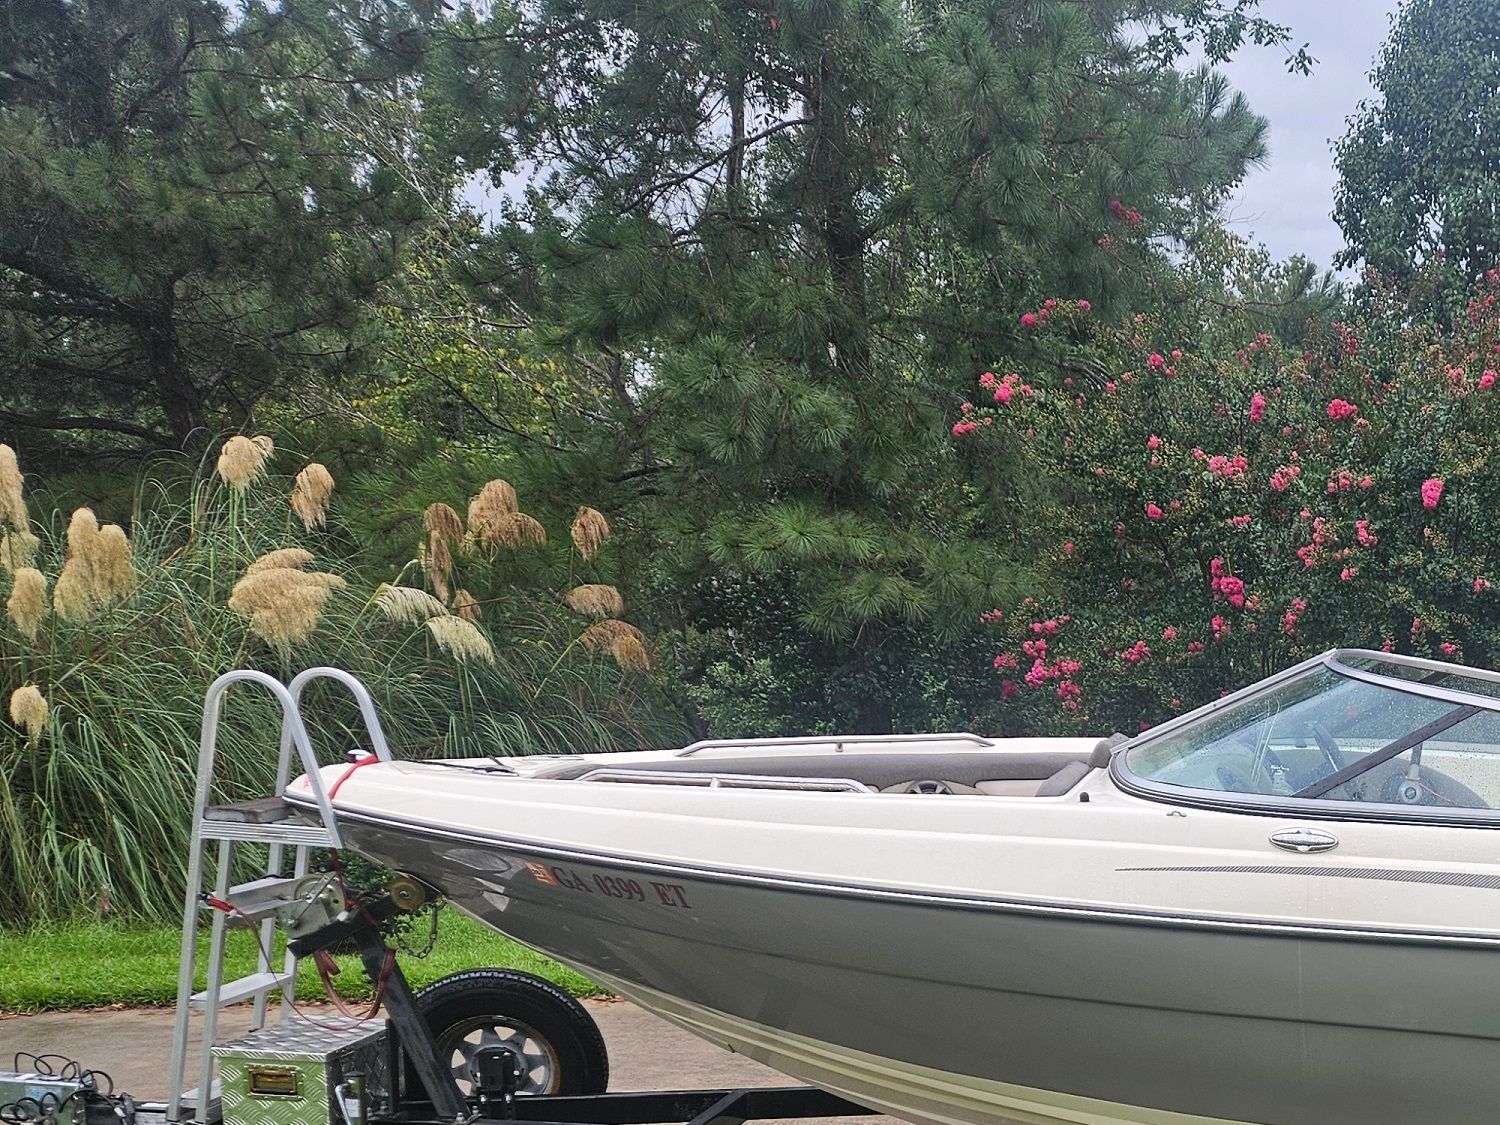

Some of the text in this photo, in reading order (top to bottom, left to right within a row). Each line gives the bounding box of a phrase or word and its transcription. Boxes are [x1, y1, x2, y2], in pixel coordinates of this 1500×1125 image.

[551, 866, 593, 893] GA
[592, 873, 646, 902] 0399
[649, 881, 692, 909] ET
